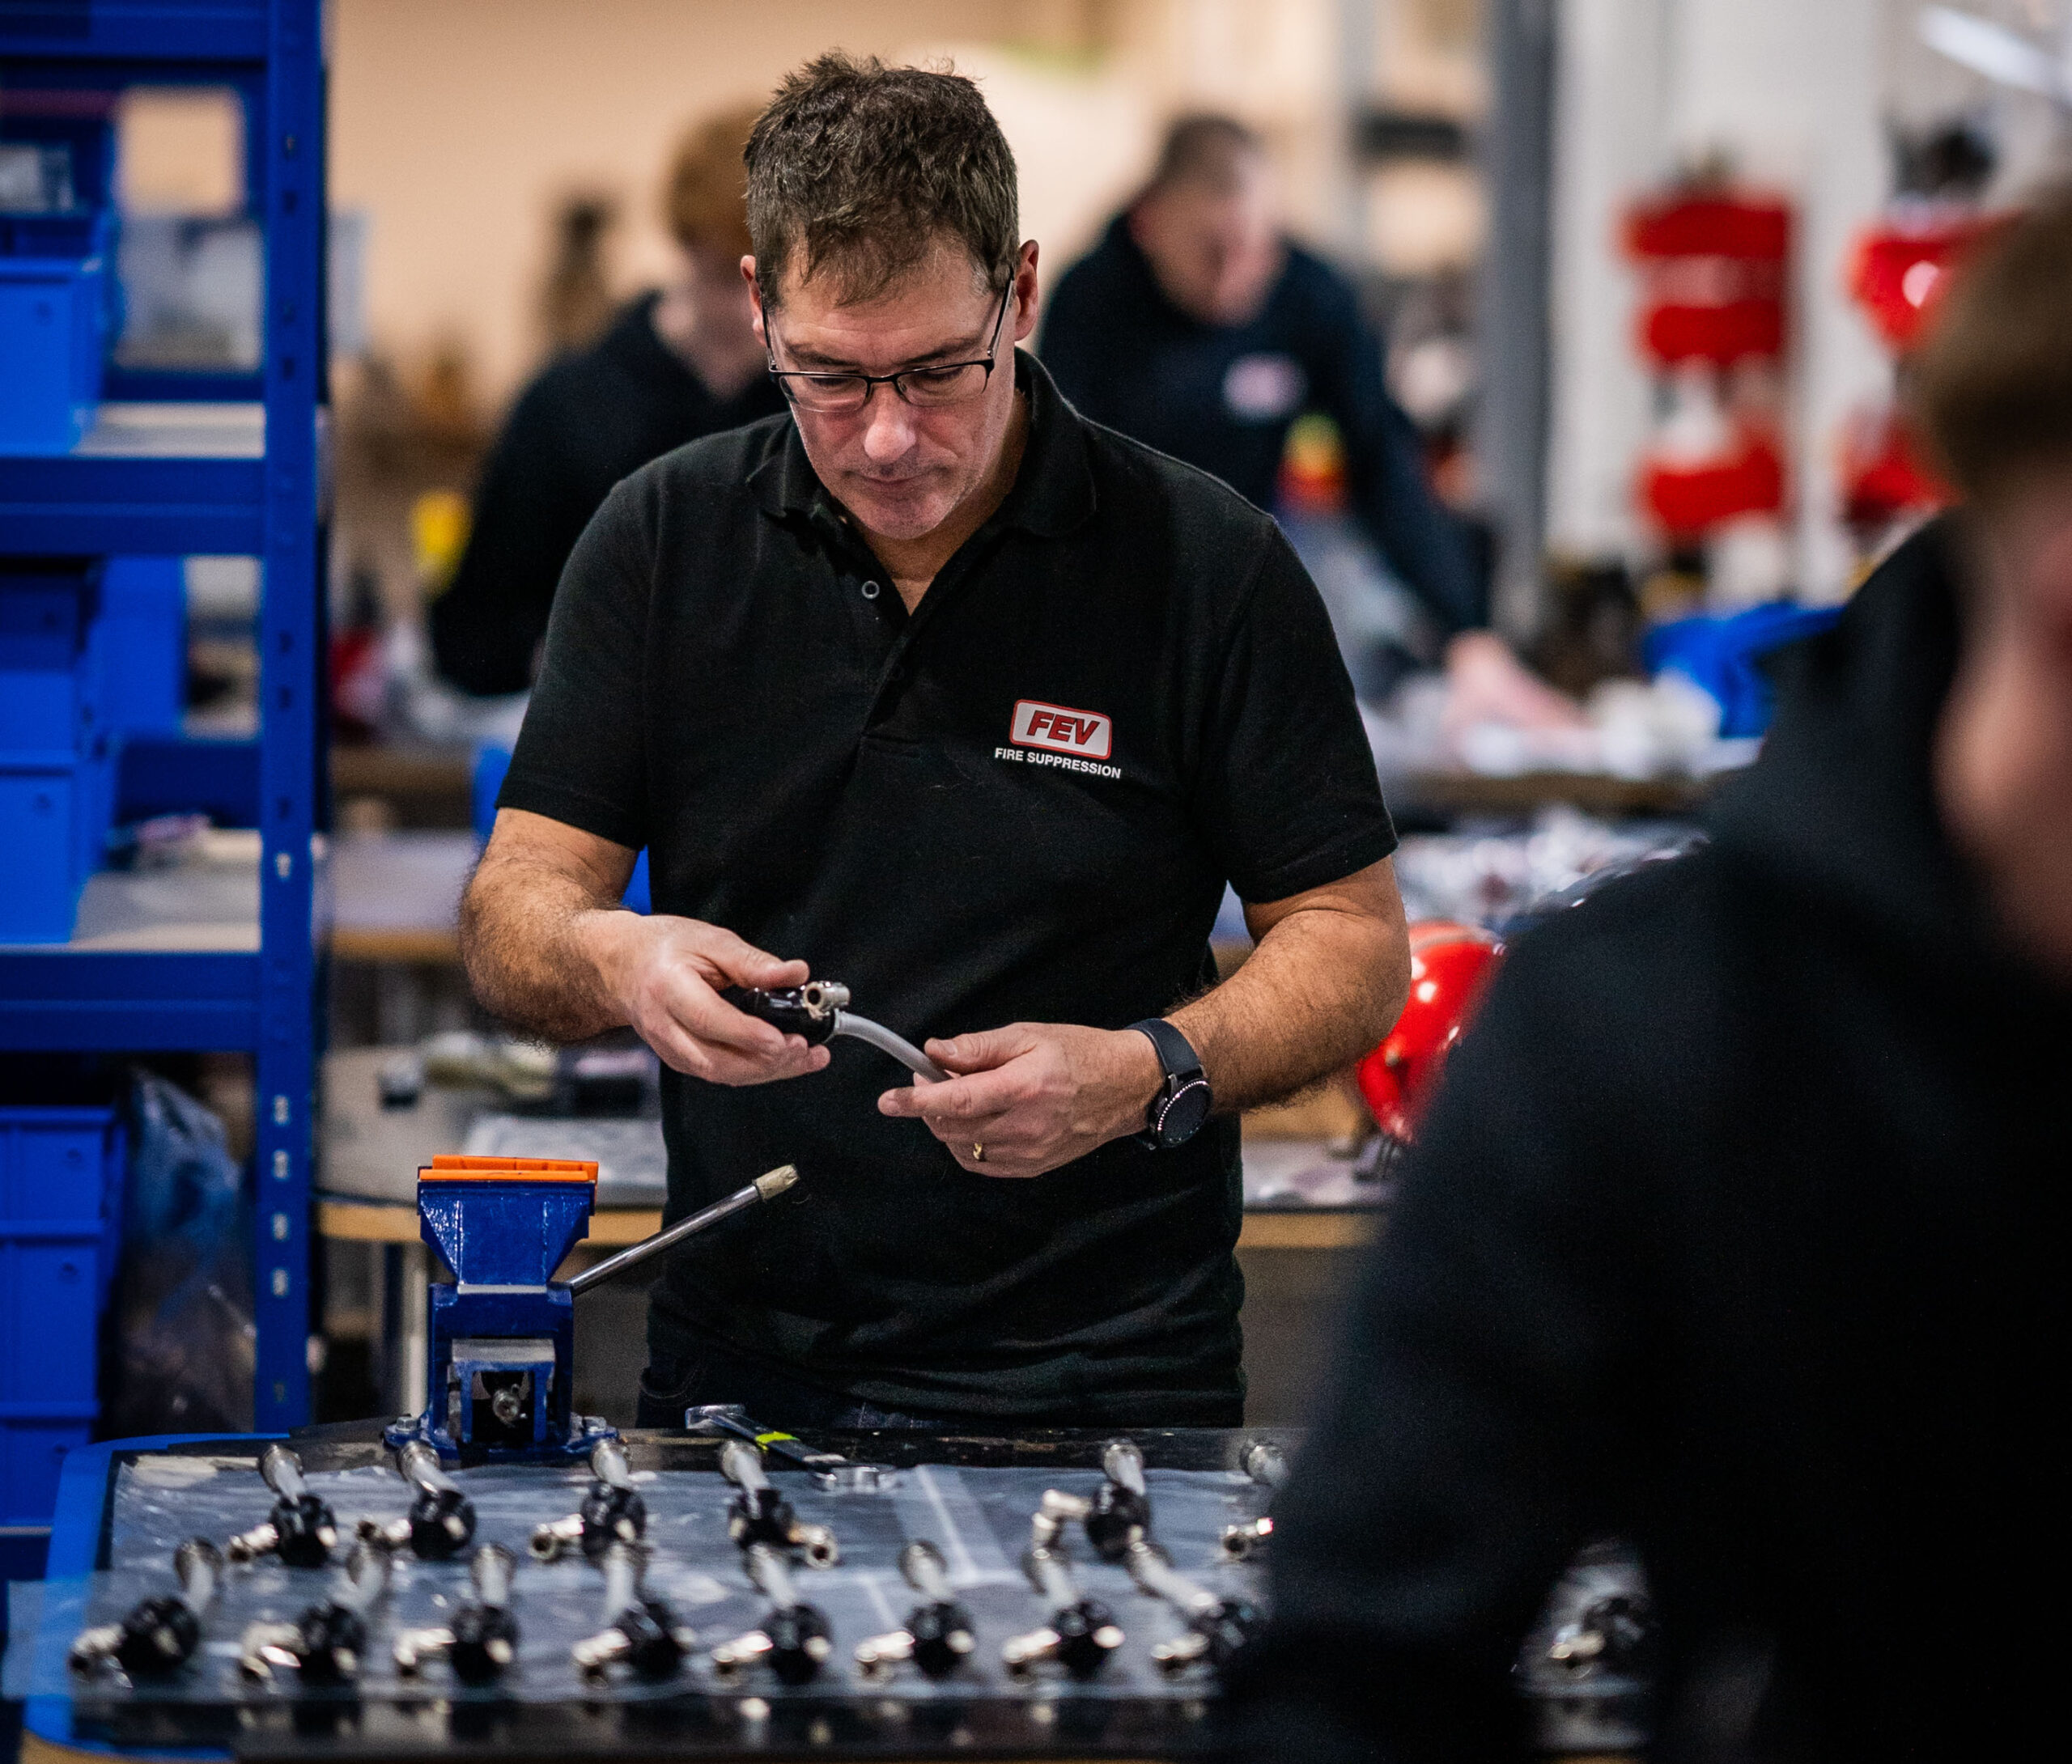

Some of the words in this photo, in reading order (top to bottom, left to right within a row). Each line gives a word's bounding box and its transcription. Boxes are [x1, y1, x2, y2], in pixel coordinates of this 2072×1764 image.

[1026, 710, 1100, 745] FEV
[995, 748, 1024, 761] FIRE
[1027, 752, 1121, 778] SUPPRESSION
